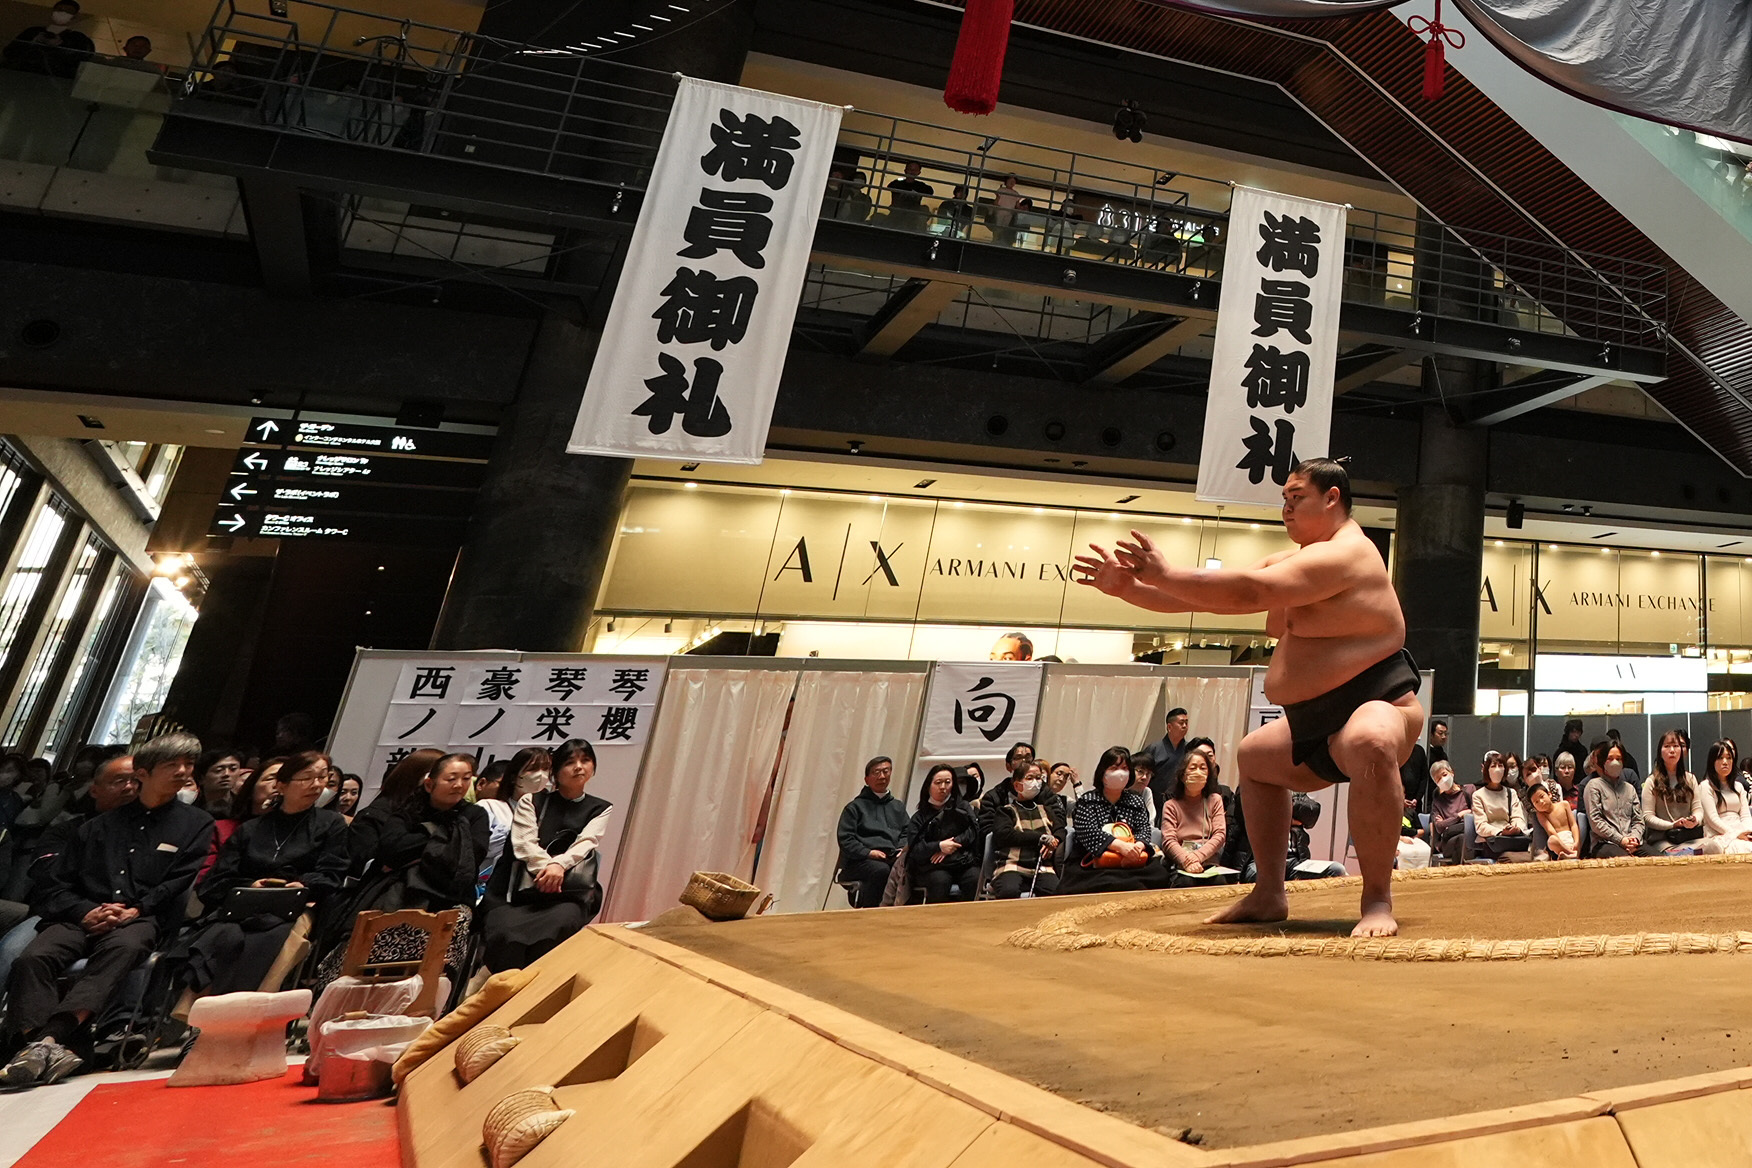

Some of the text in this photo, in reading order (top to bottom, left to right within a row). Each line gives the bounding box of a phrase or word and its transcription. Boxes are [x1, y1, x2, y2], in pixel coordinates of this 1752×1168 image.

[631, 108, 801, 437] 満員御礼
[1235, 210, 1321, 486] 満員御礼
[929, 558, 1026, 580] ARMANI
[1569, 591, 1630, 608] ARMANI
[531, 667, 588, 756] 琴栄
[597, 668, 650, 741] 琴櫻
[952, 677, 1016, 743] 向
